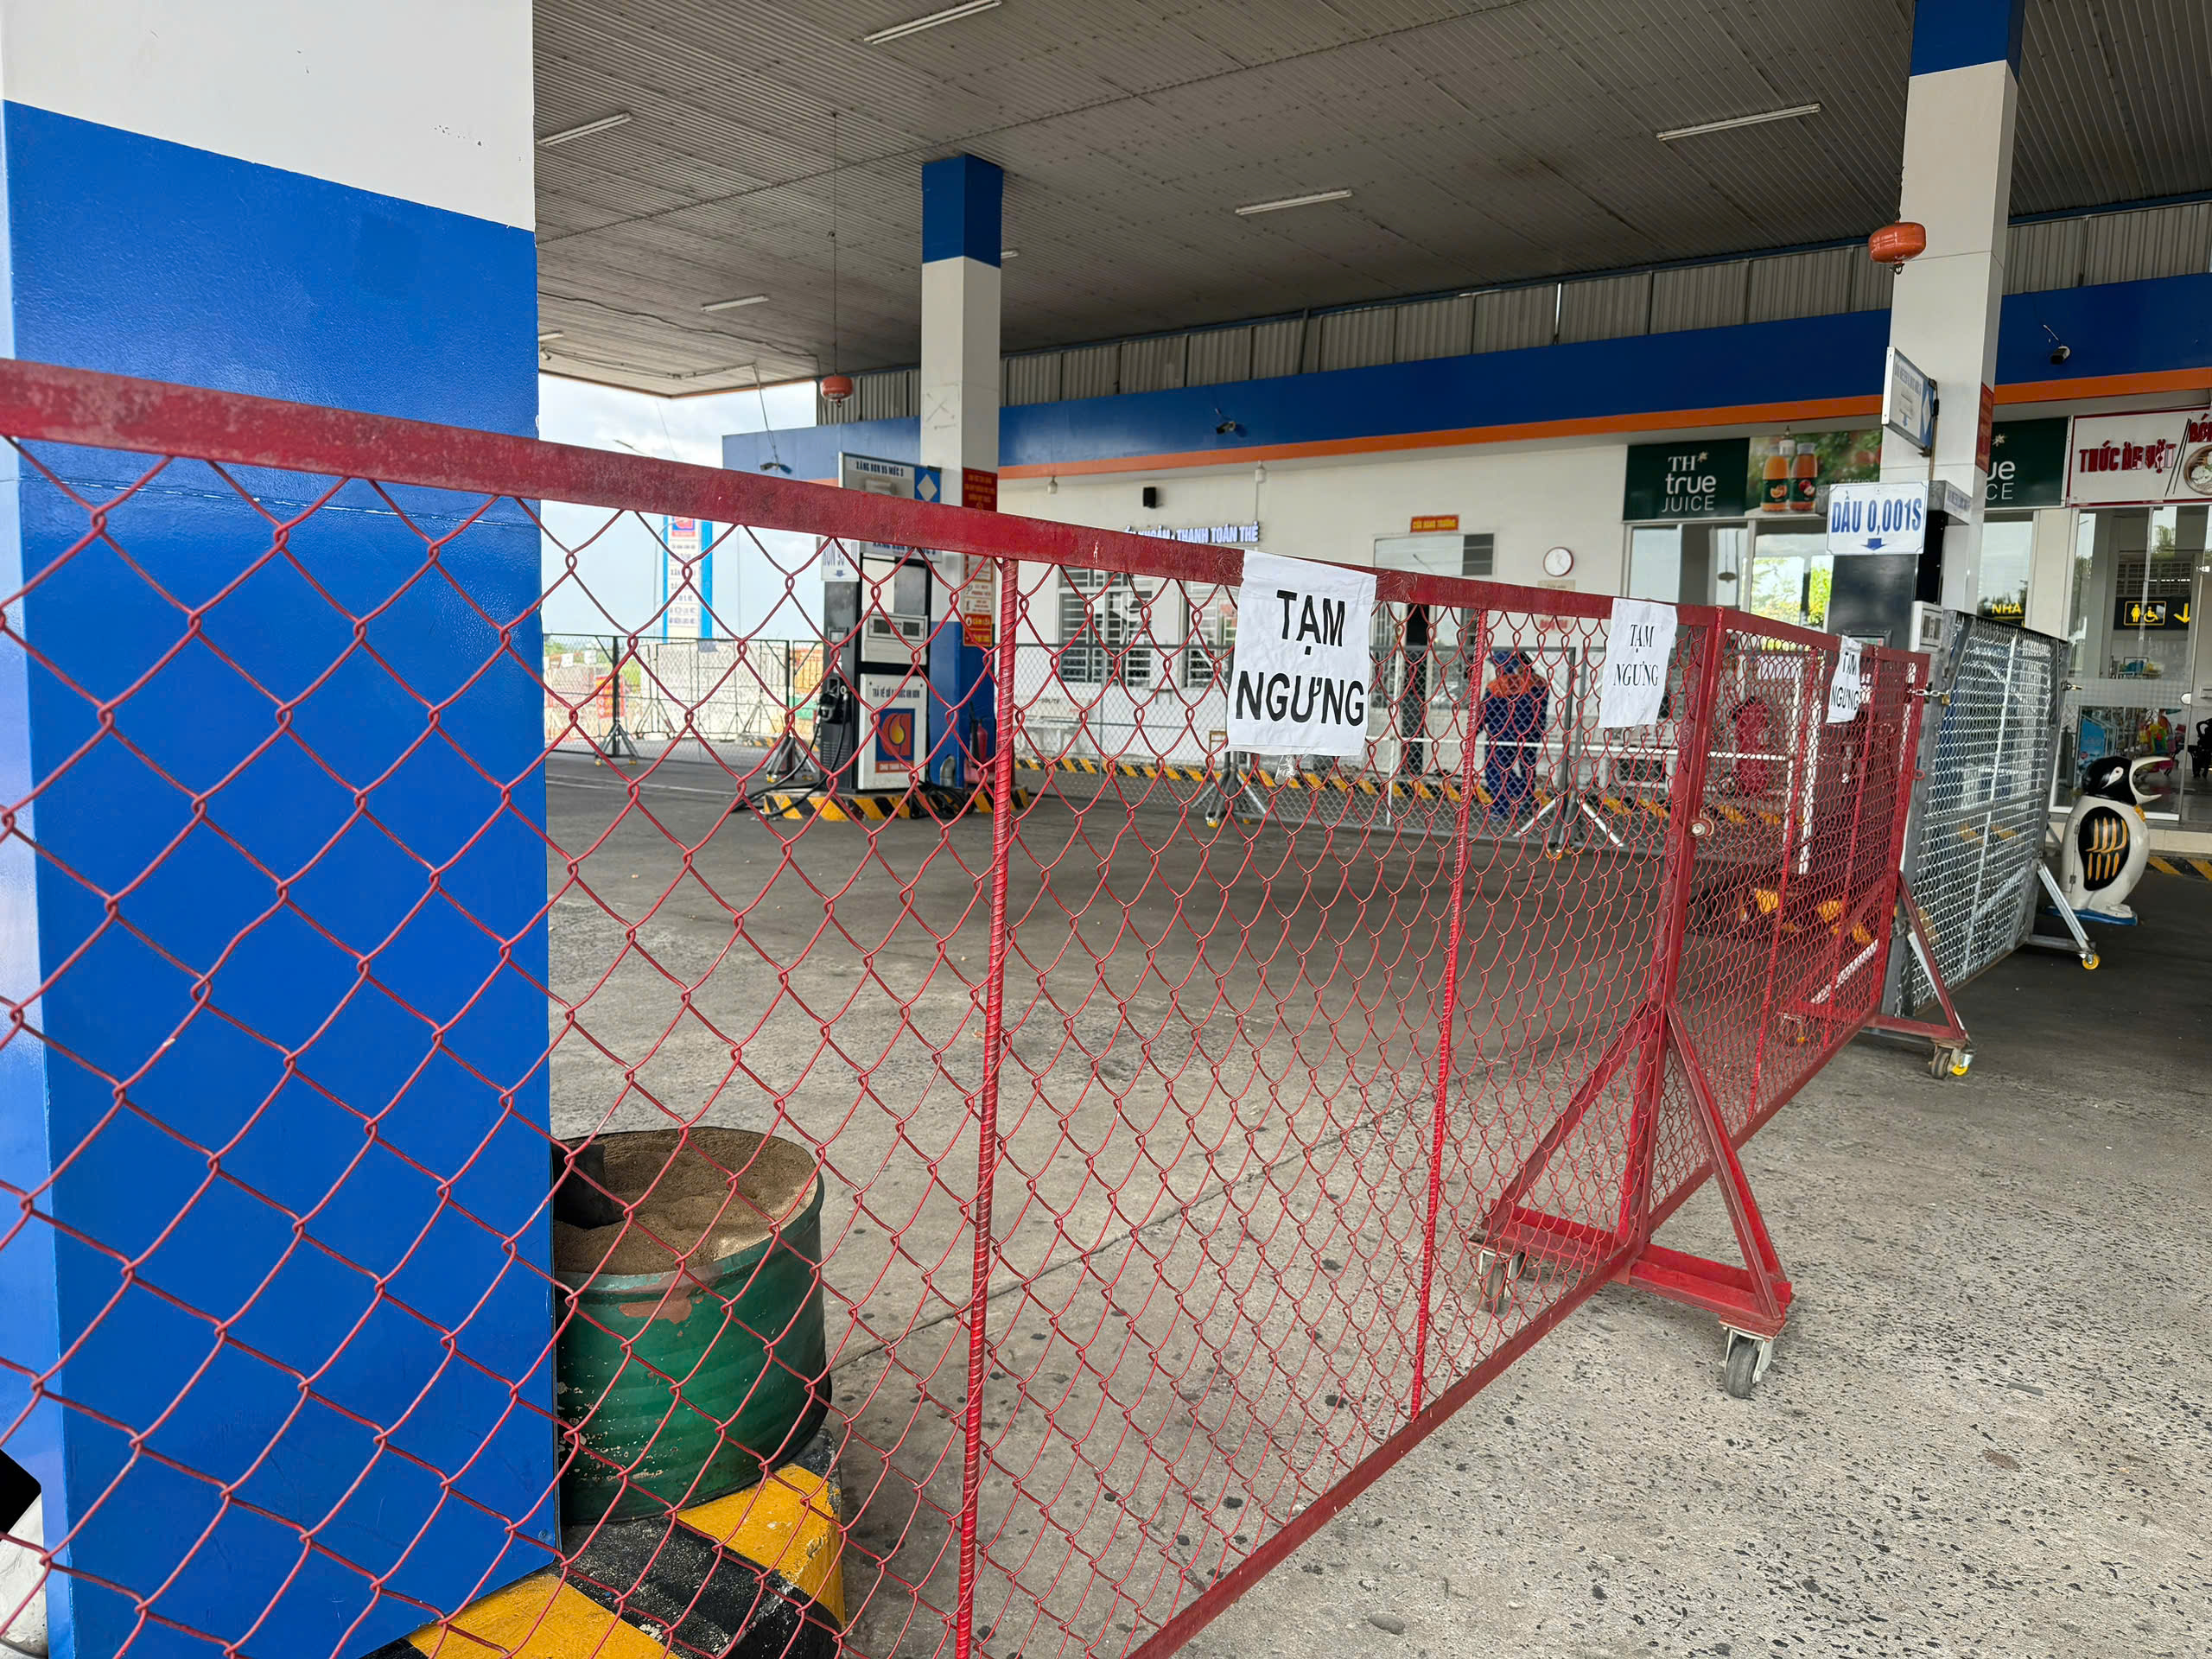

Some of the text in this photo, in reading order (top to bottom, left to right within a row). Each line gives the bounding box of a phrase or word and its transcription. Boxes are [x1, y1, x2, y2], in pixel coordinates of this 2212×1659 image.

[1668, 455, 1696, 472] TH
[2079, 439, 2120, 474] THỨC
[1986, 461, 2016, 480] ue
[1665, 473, 1717, 495] true
[1662, 495, 1715, 512] JUICE
[1831, 491, 1862, 533] DẦU
[1867, 498, 1923, 535] 0,001S
[1176, 528, 1210, 543] THANH
[1211, 524, 1238, 543] TOÁN
[1239, 520, 1259, 543] THẺ
[1276, 589, 1345, 656] TẠM
[1630, 624, 1656, 653] TẠM
[1613, 661, 1659, 687] NGƯNG
[1236, 671, 1364, 727] NGƯNG
